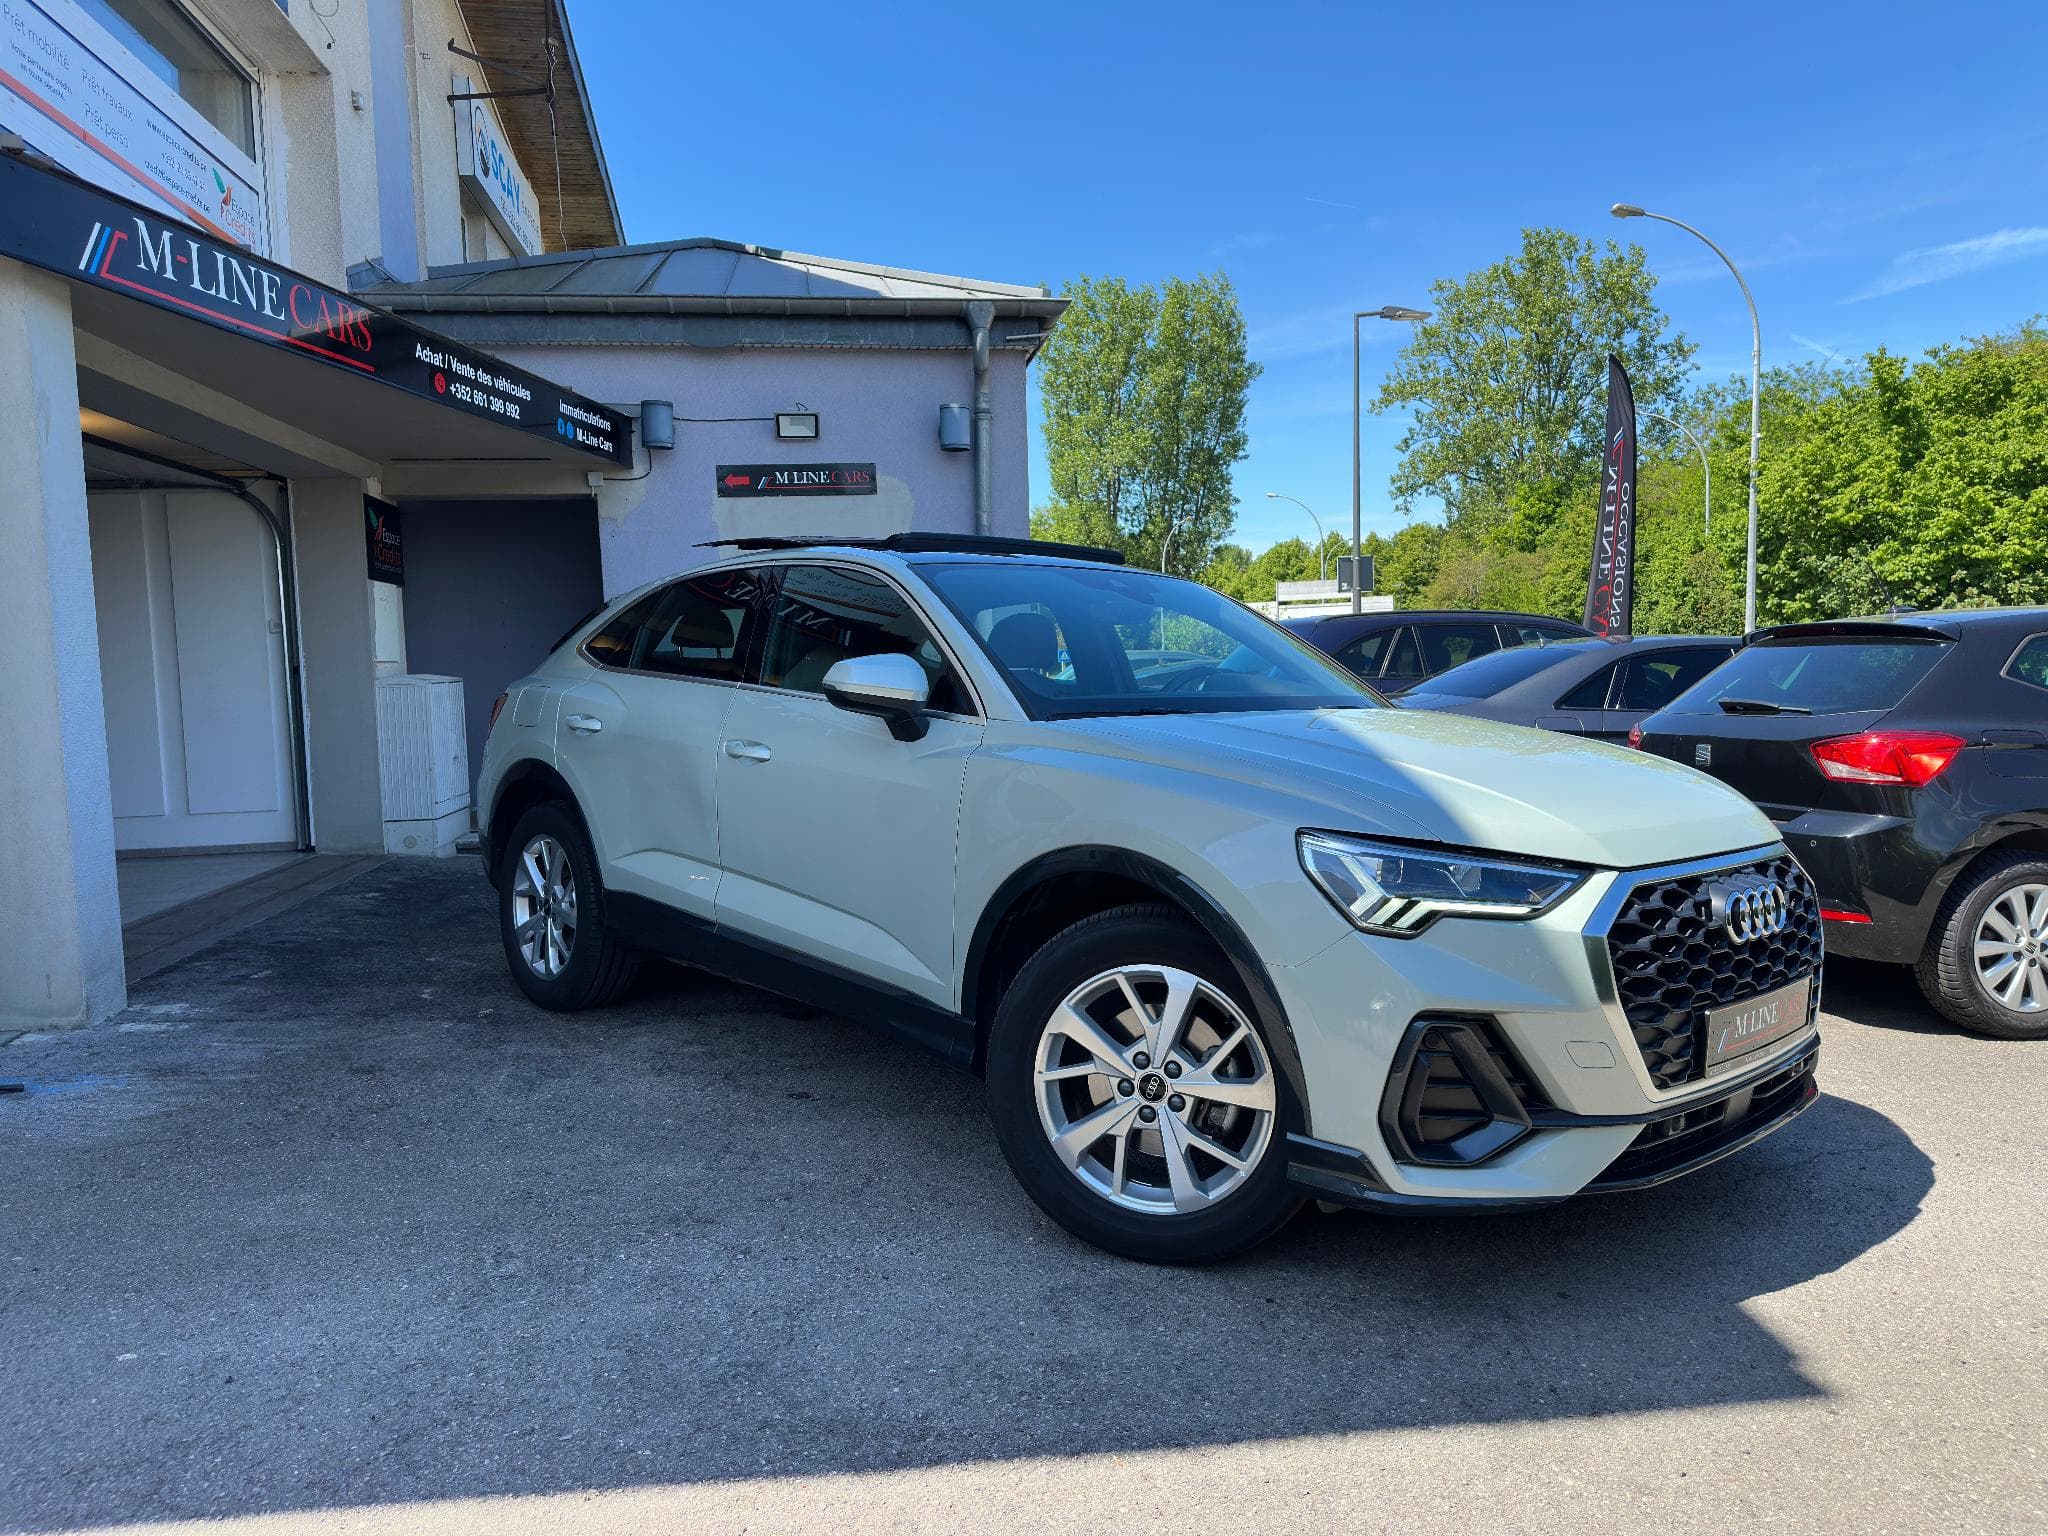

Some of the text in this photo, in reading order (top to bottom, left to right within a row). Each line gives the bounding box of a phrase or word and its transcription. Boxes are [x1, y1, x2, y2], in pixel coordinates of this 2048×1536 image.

[28, 30, 70, 70] mobilité
[101, 87, 135, 121] travaux
[490, 139, 519, 215] SCAY
[132, 216, 373, 352] M-LINE CARS
[415, 342, 444, 369] Achat
[449, 355, 476, 380] Vente
[477, 368, 492, 387] des
[493, 375, 531, 401] véhicules
[449, 382, 520, 420] +352 661 399 992
[559, 398, 612, 432] Immatriculations
[576, 427, 613, 453] M-Line Cars
[774, 470, 870, 485] M-LINE CARS
[1734, 1000, 1779, 1038] M-LINE
